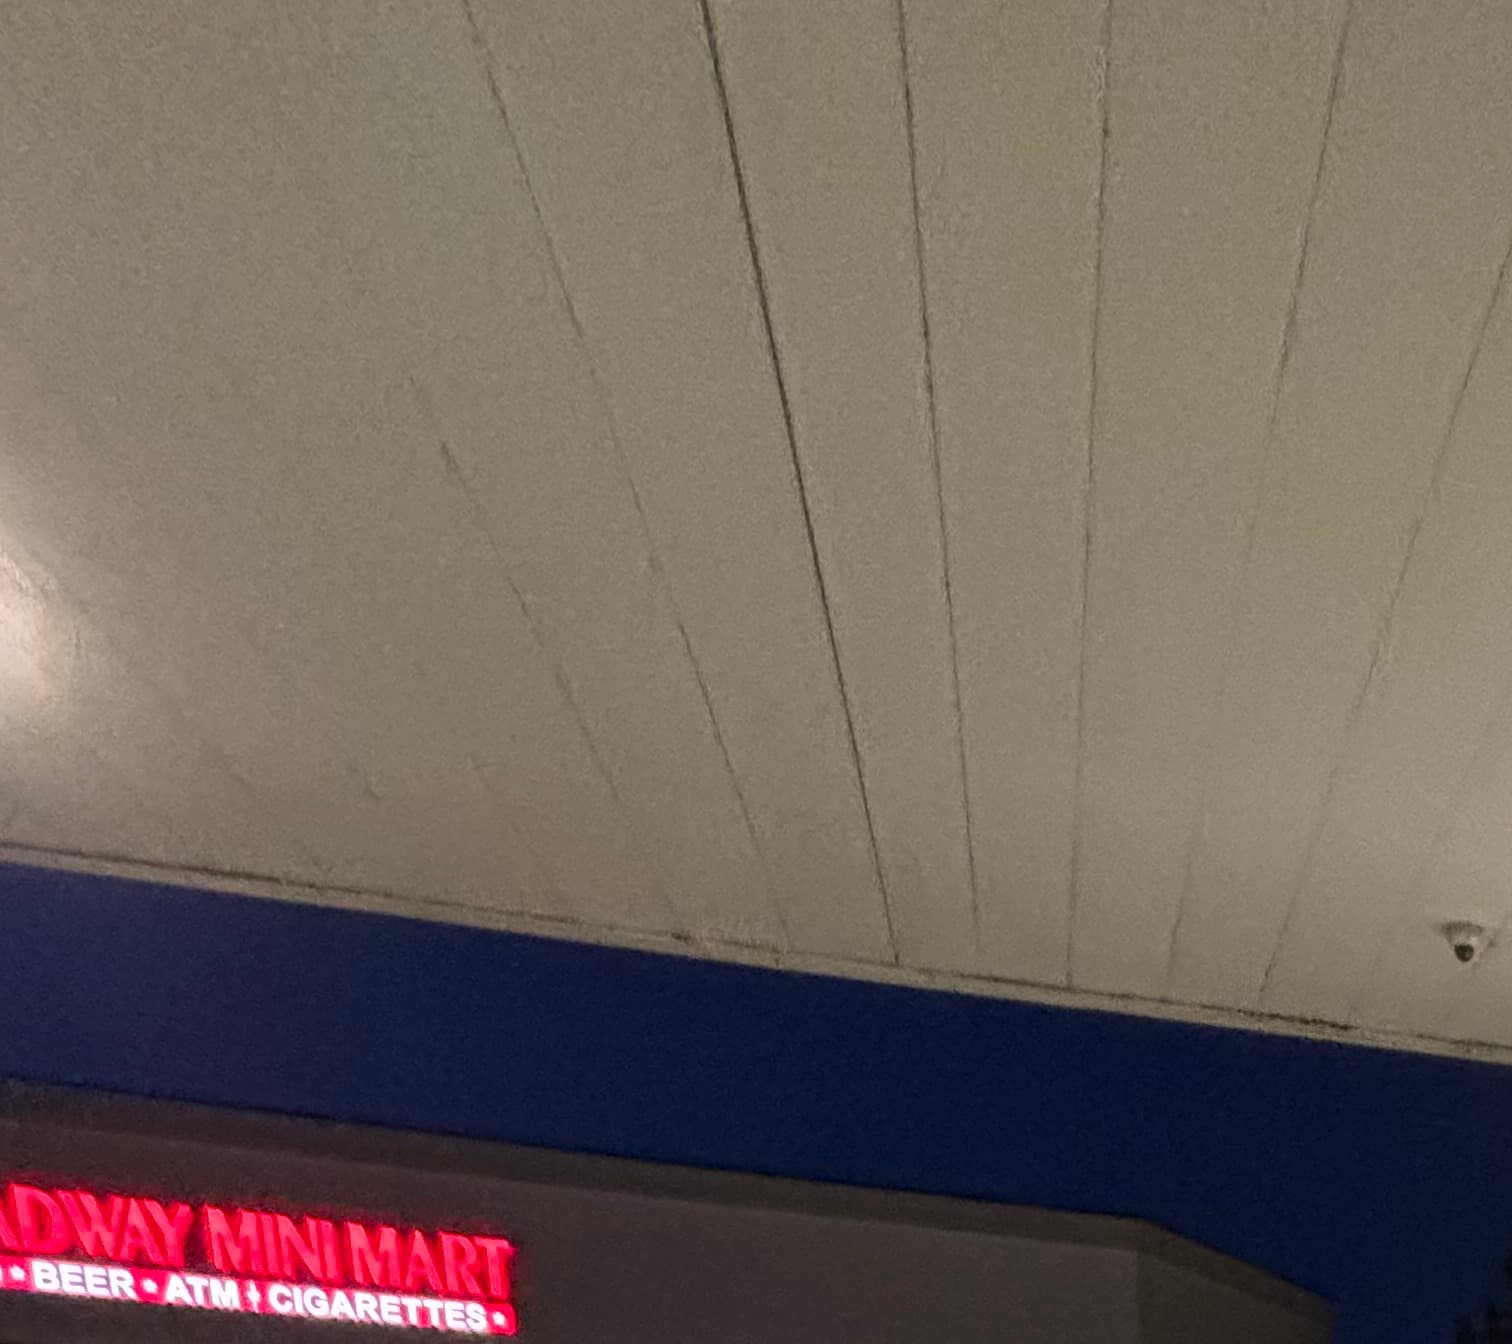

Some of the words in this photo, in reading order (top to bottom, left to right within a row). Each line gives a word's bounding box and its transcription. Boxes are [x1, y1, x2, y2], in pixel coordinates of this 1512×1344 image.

[203, 1203, 341, 1283] MINI
[345, 1221, 517, 1299] MART
[31, 1259, 137, 1301] BEER
[165, 1273, 241, 1309] ATM
[268, 1283, 488, 1333] CIGARETTES
